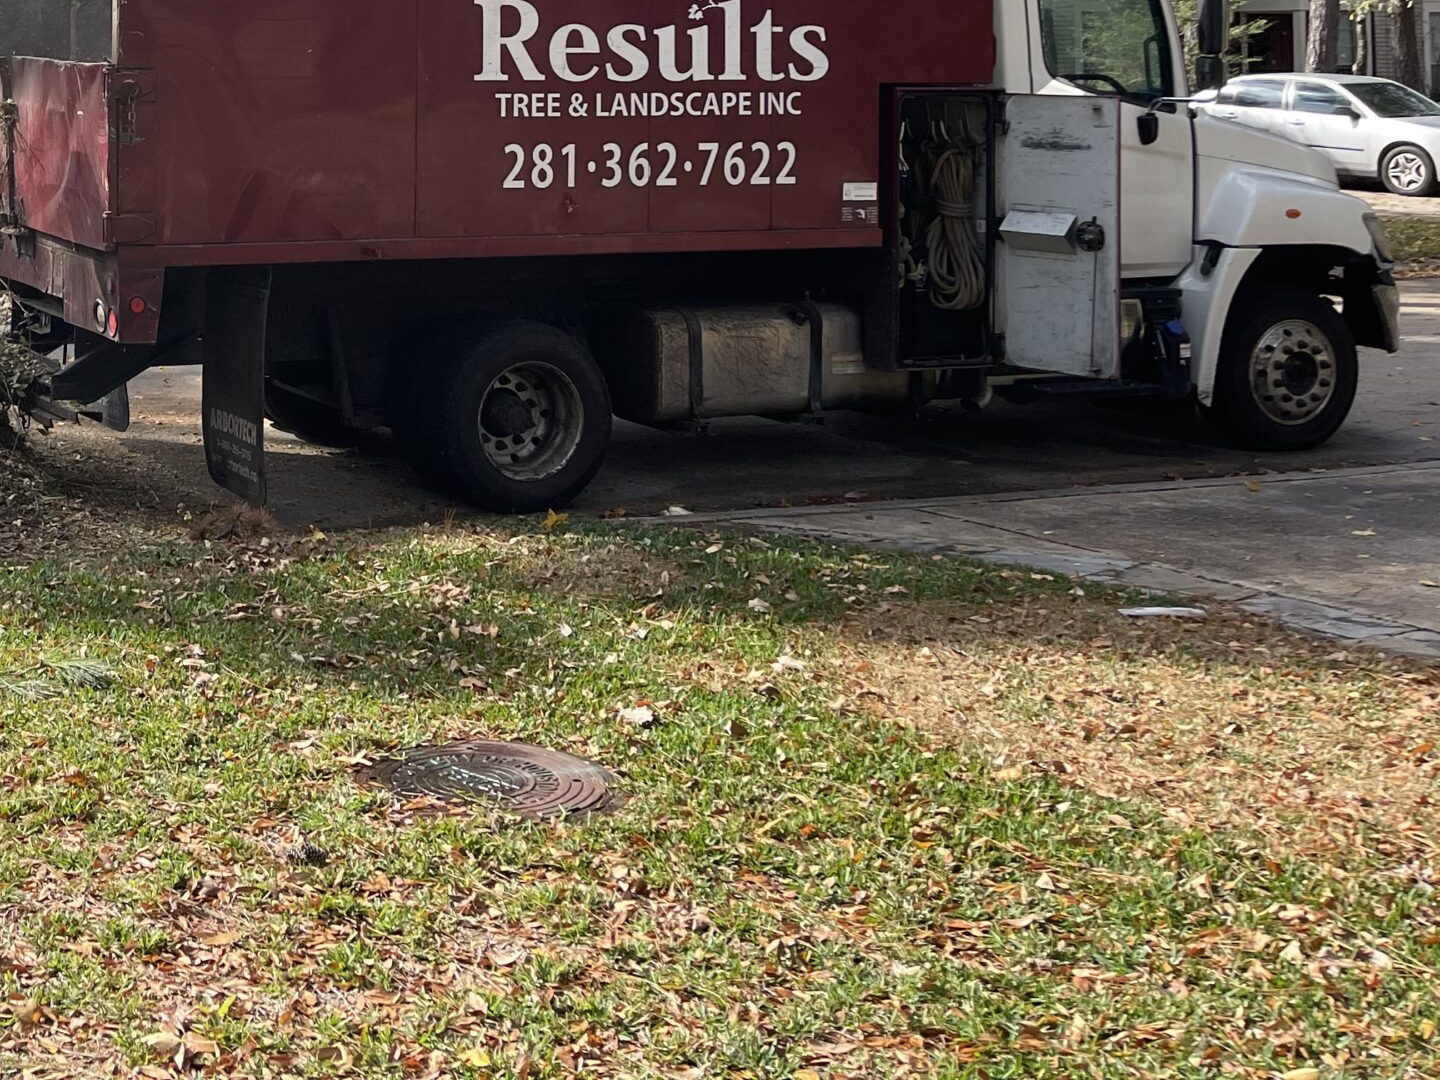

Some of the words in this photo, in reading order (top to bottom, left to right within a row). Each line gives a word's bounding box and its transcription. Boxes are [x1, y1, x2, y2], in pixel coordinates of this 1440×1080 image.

[495, 92, 561, 118] TREE
[568, 92, 589, 117] &
[595, 91, 752, 118] LANDSCAPE
[759, 91, 802, 116] INC
[210, 407, 257, 447] ARBORTECH
